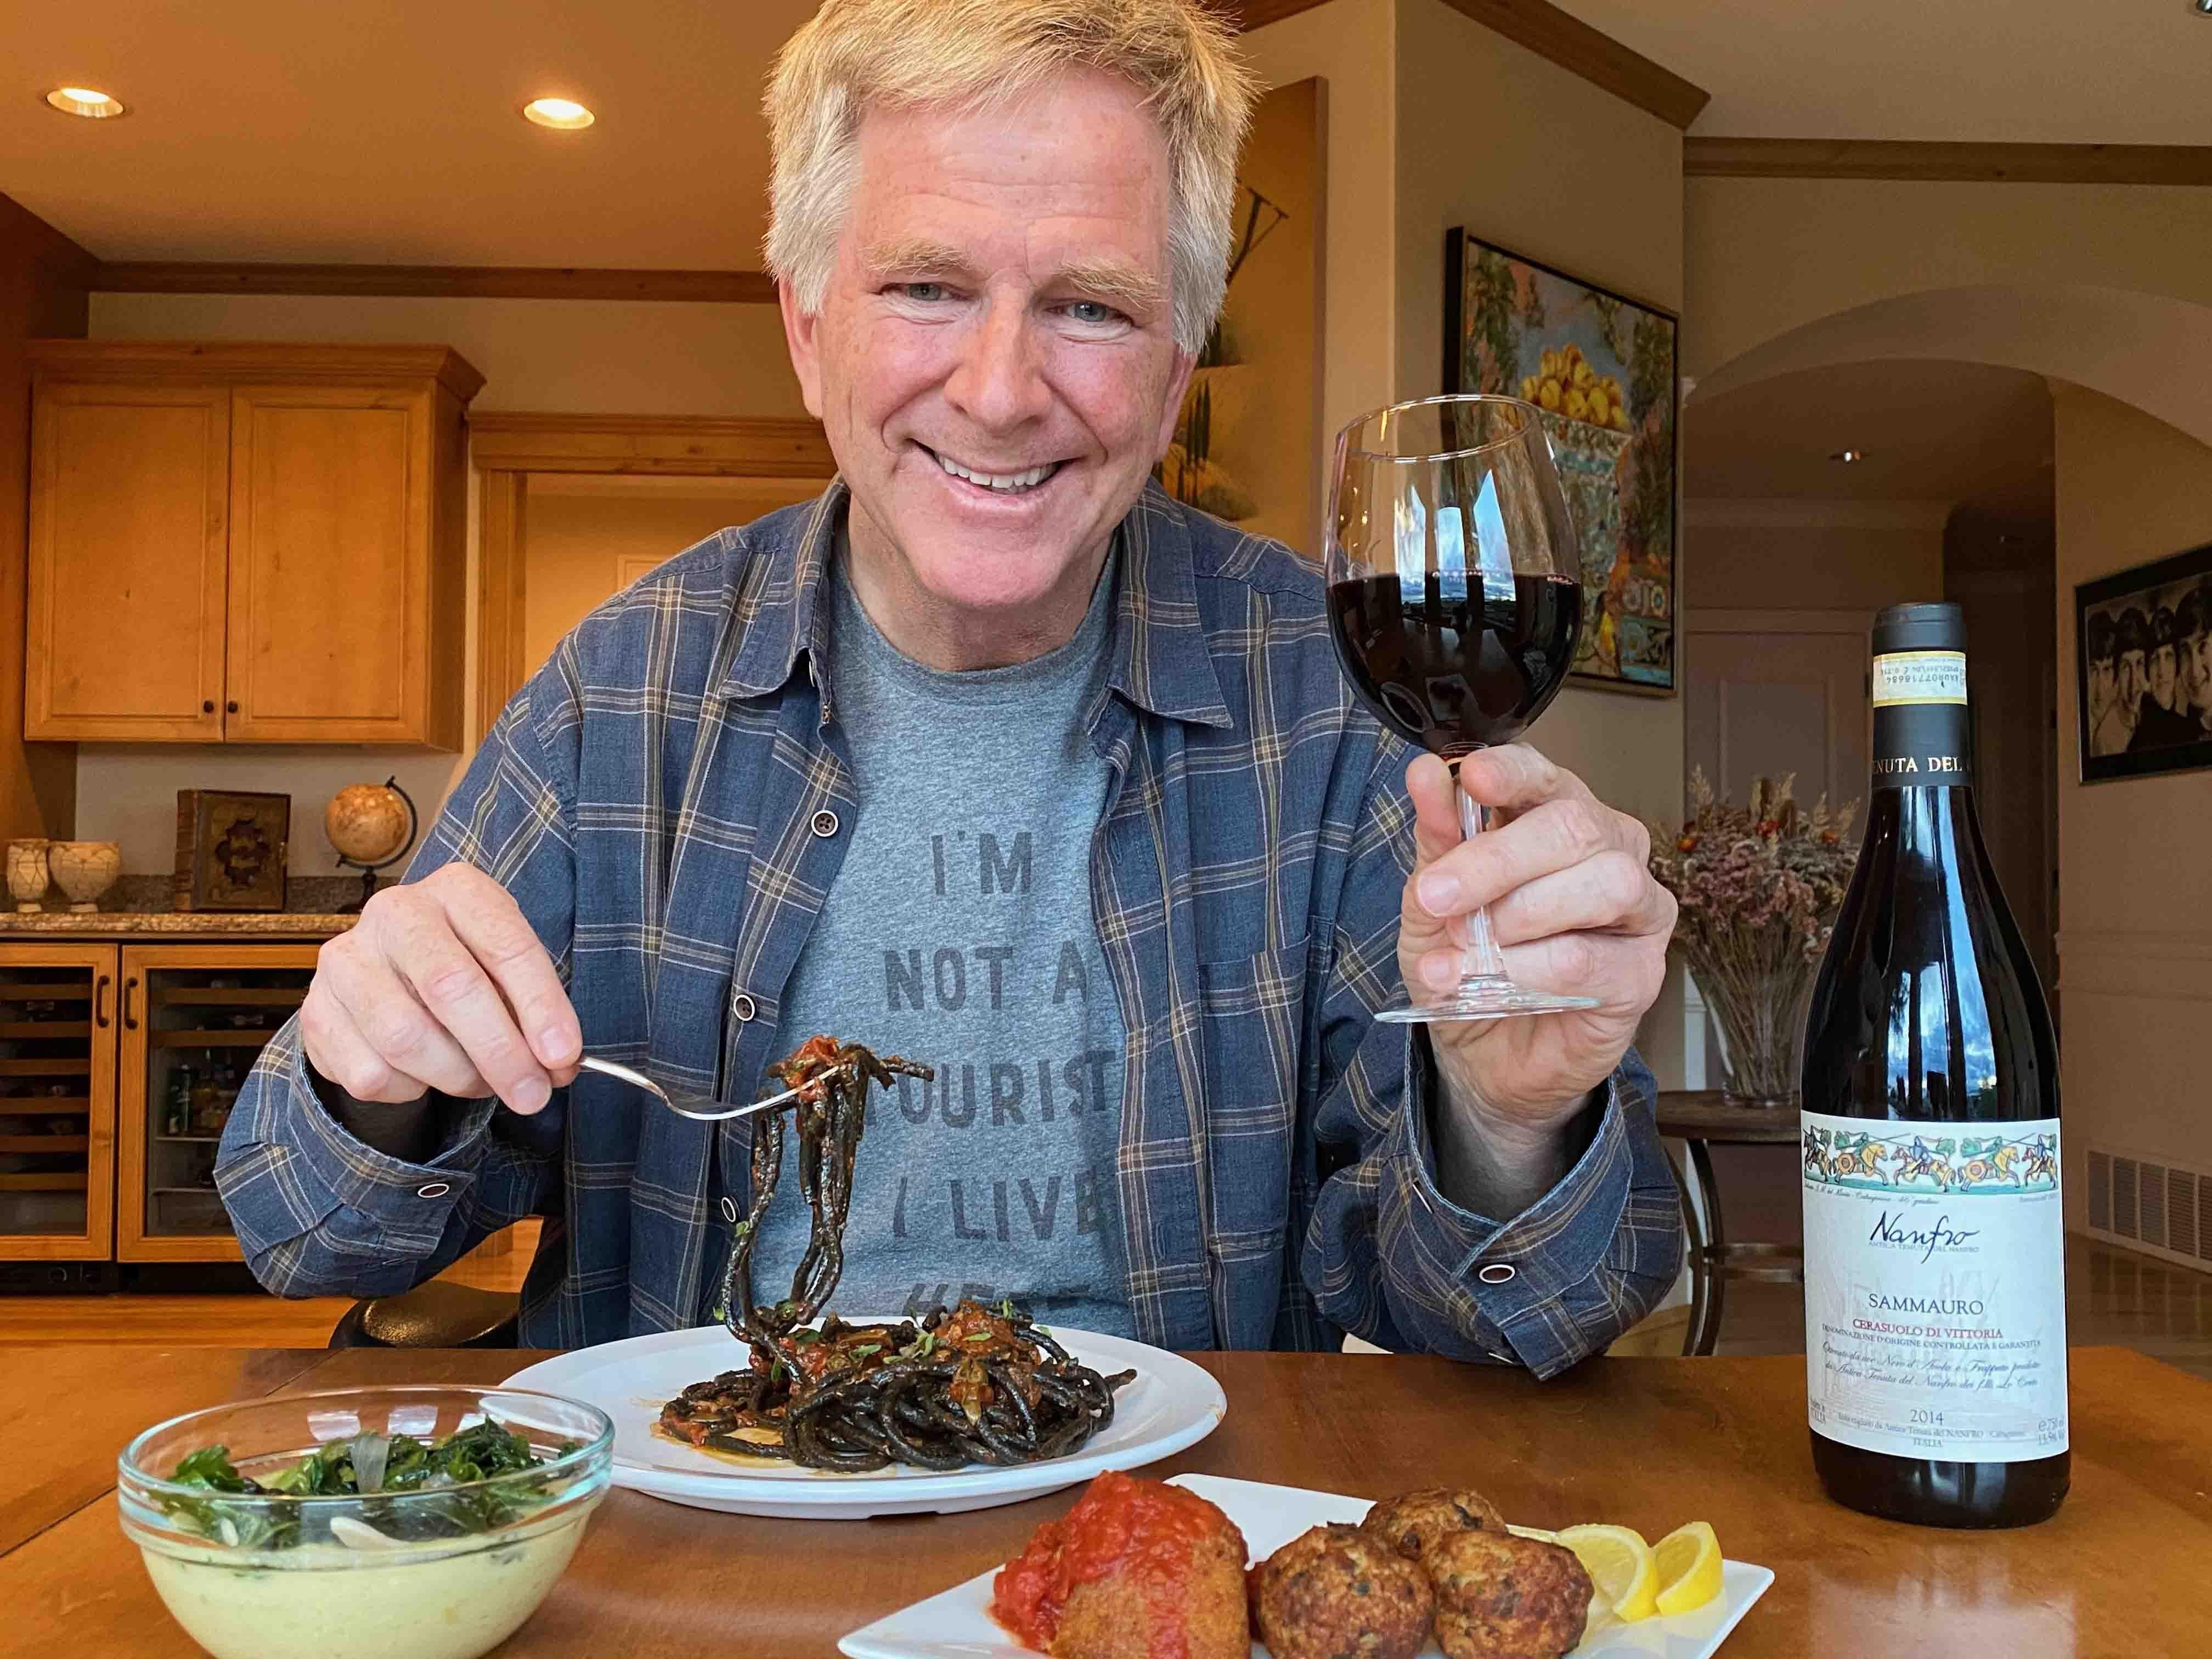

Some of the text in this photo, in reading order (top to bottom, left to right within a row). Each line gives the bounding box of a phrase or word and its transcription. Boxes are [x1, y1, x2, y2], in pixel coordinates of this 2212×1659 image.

[1927, 756, 1962, 772] DEL
[931, 831, 1033, 895] I'M
[884, 940, 1088, 1011] NOT A
[866, 1050, 1116, 1128] OURIST
[893, 1177, 909, 1238] I
[1869, 1210, 1980, 1265] Nanfro
[1869, 1293, 1984, 1316] SAMMAURO
[1822, 1323, 1876, 1341] DENOMINAZIONE
[1877, 1335, 1922, 1347] D'ORIGINE
[1923, 1341, 1989, 1350] CONTROLLATA
[1998, 1339, 2041, 1349] GARANTITA
[1853, 1318, 2003, 1339] CERASUOLO DI VITTORIA
[1910, 1409, 1945, 1425] 2014
